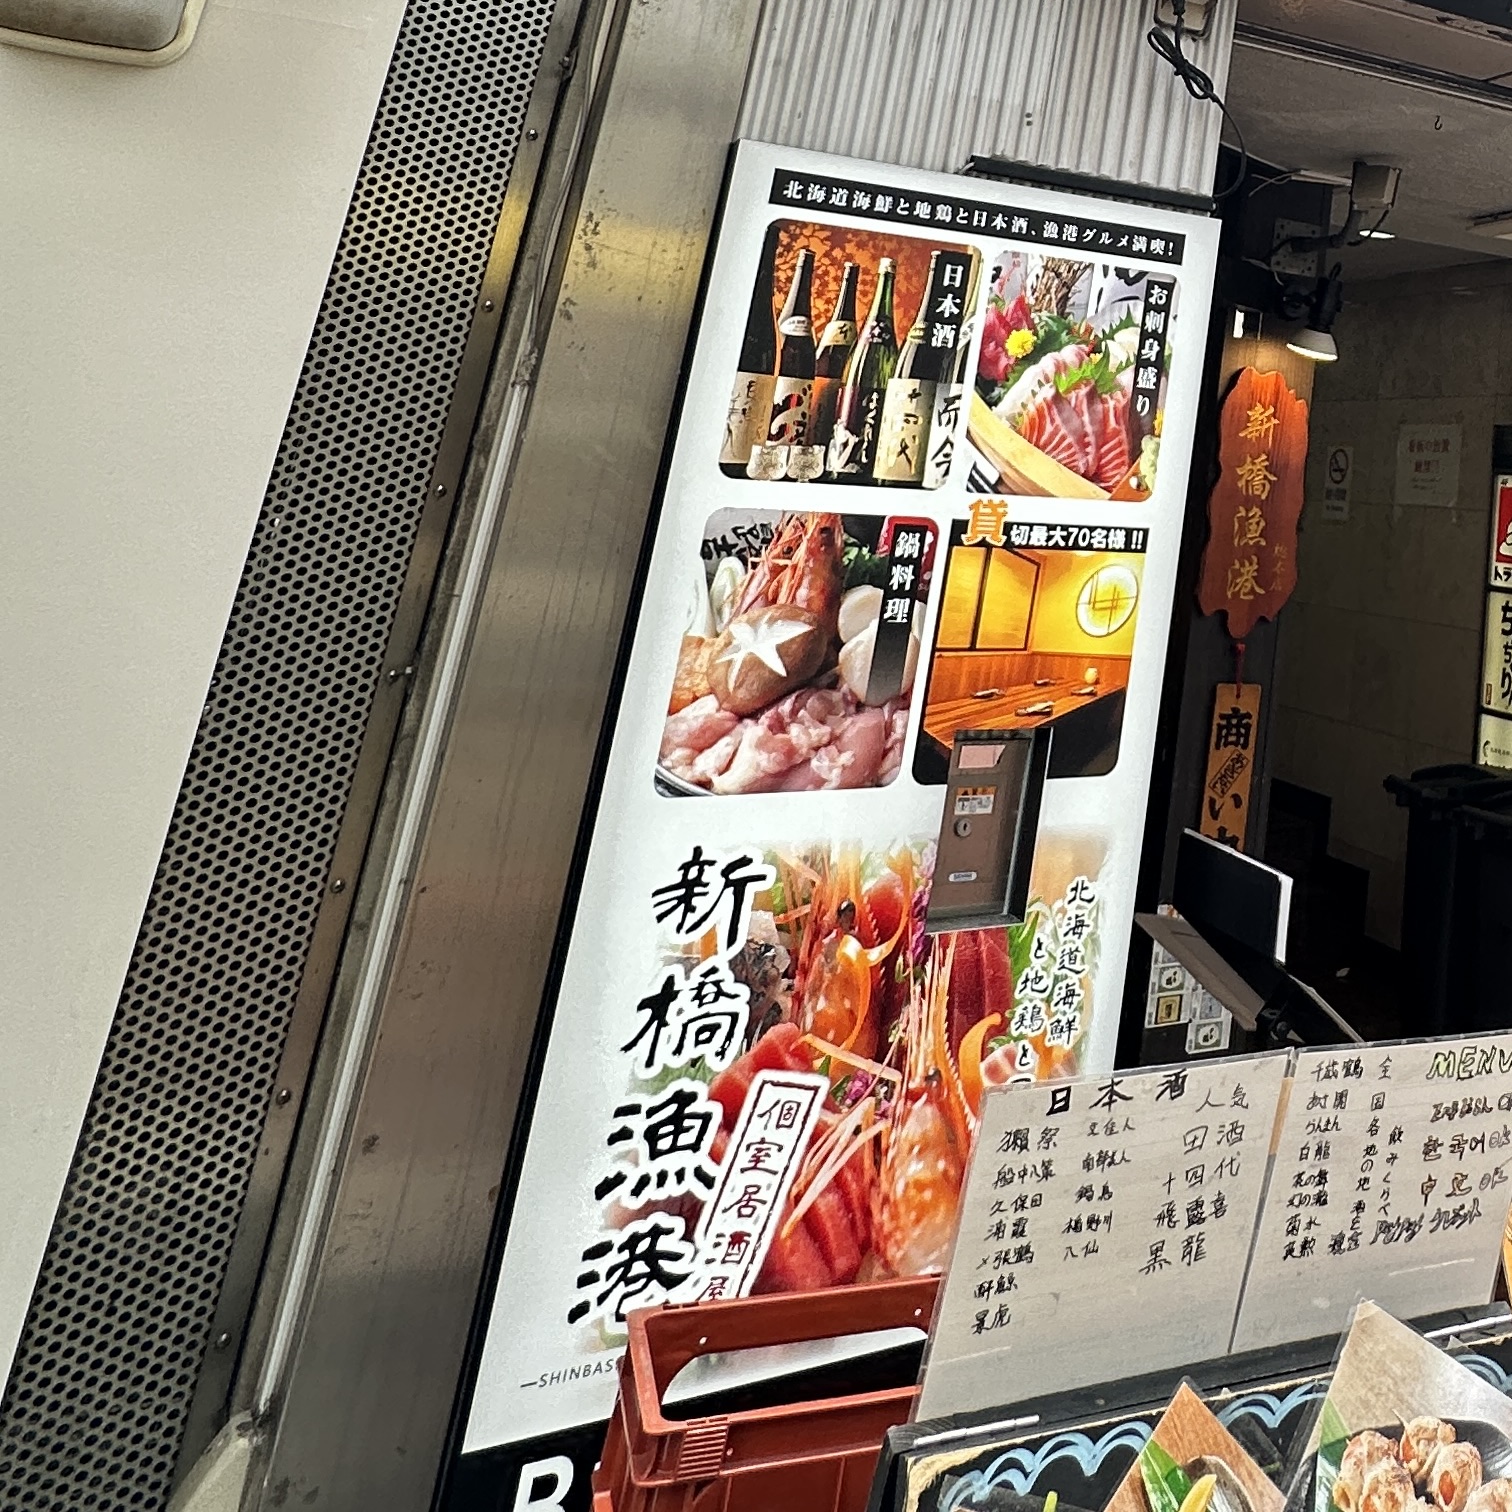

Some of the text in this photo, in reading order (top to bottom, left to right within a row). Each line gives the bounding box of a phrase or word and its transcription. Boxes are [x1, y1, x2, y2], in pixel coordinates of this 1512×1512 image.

[931, 262, 965, 350] 日本酒
[1136, 284, 1170, 418] お刺身盛り
[1226, 402, 1279, 601] 新橋漁港
[882, 530, 920, 624] 鍋料理
[1046, 878, 1096, 1049] 北海道海鮮
[1010, 938, 1050, 1085] と地鶏と
[567, 845, 768, 1324] 新橋漁港
[1046, 1069, 1189, 1116] 日本酒
[1196, 1083, 1249, 1113] 人気
[1162, 1151, 1241, 1196] 十四代
[1183, 1119, 1244, 1155] 田酒
[1422, 1131, 1485, 1162] 한국어
[702, 1096, 798, 1300] 個室居酒屋
[989, 1192, 1043, 1217] 久保田
